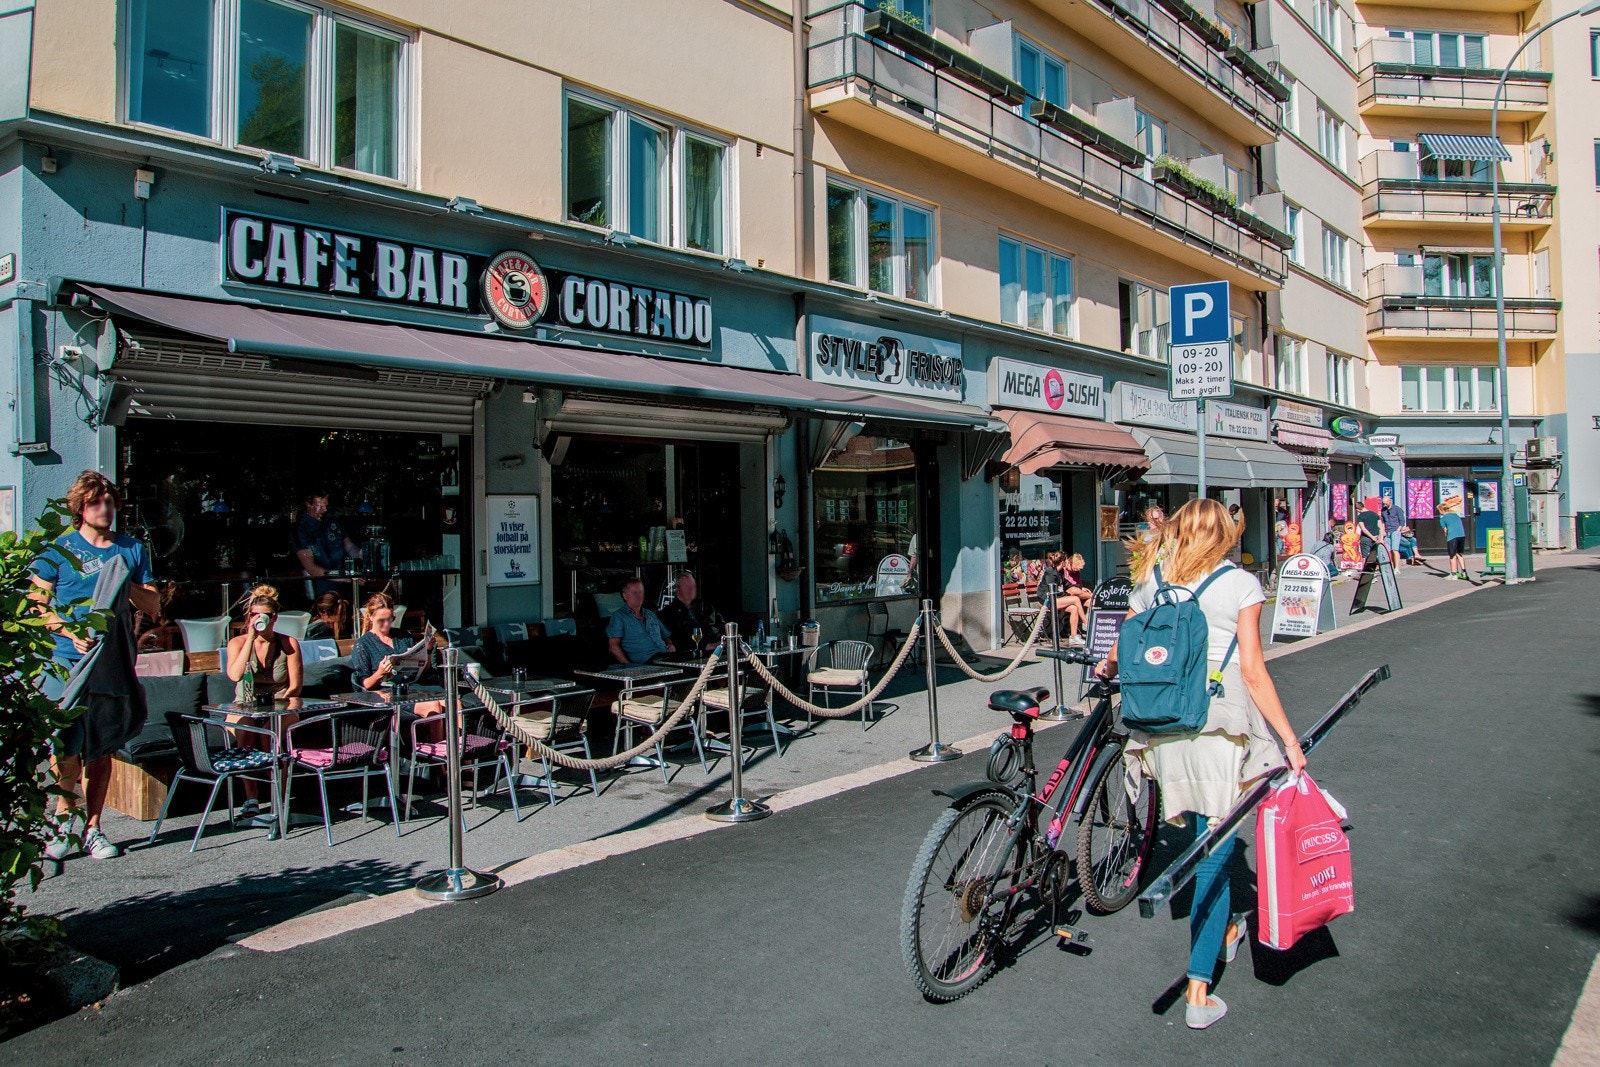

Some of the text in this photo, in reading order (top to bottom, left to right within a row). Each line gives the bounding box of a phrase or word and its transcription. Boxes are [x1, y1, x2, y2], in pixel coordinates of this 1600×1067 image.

[228, 216, 470, 310] CAFE BAR
[497, 298, 537, 320] CORTADO
[559, 274, 714, 344] CORTADO
[1184, 291, 1214, 337] P
[816, 334, 964, 386] STYLE FRISØR
[1003, 370, 1100, 407] MEGA SUSHI
[1175, 377, 1194, 385] Maks
[1198, 376, 1203, 384] 2
[1181, 385, 1221, 397] mot avgift
[1225, 408, 1263, 423] ITALIENSK PIZZA
[501, 522, 525, 532] Vi viser
[1005, 515, 1050, 528] 22 22 05 55
[496, 531, 529, 544] fotball på
[494, 544, 531, 555] storskjerm!
[1302, 832, 1337, 851] PRINCESS
[1310, 866, 1336, 887] WOW!
